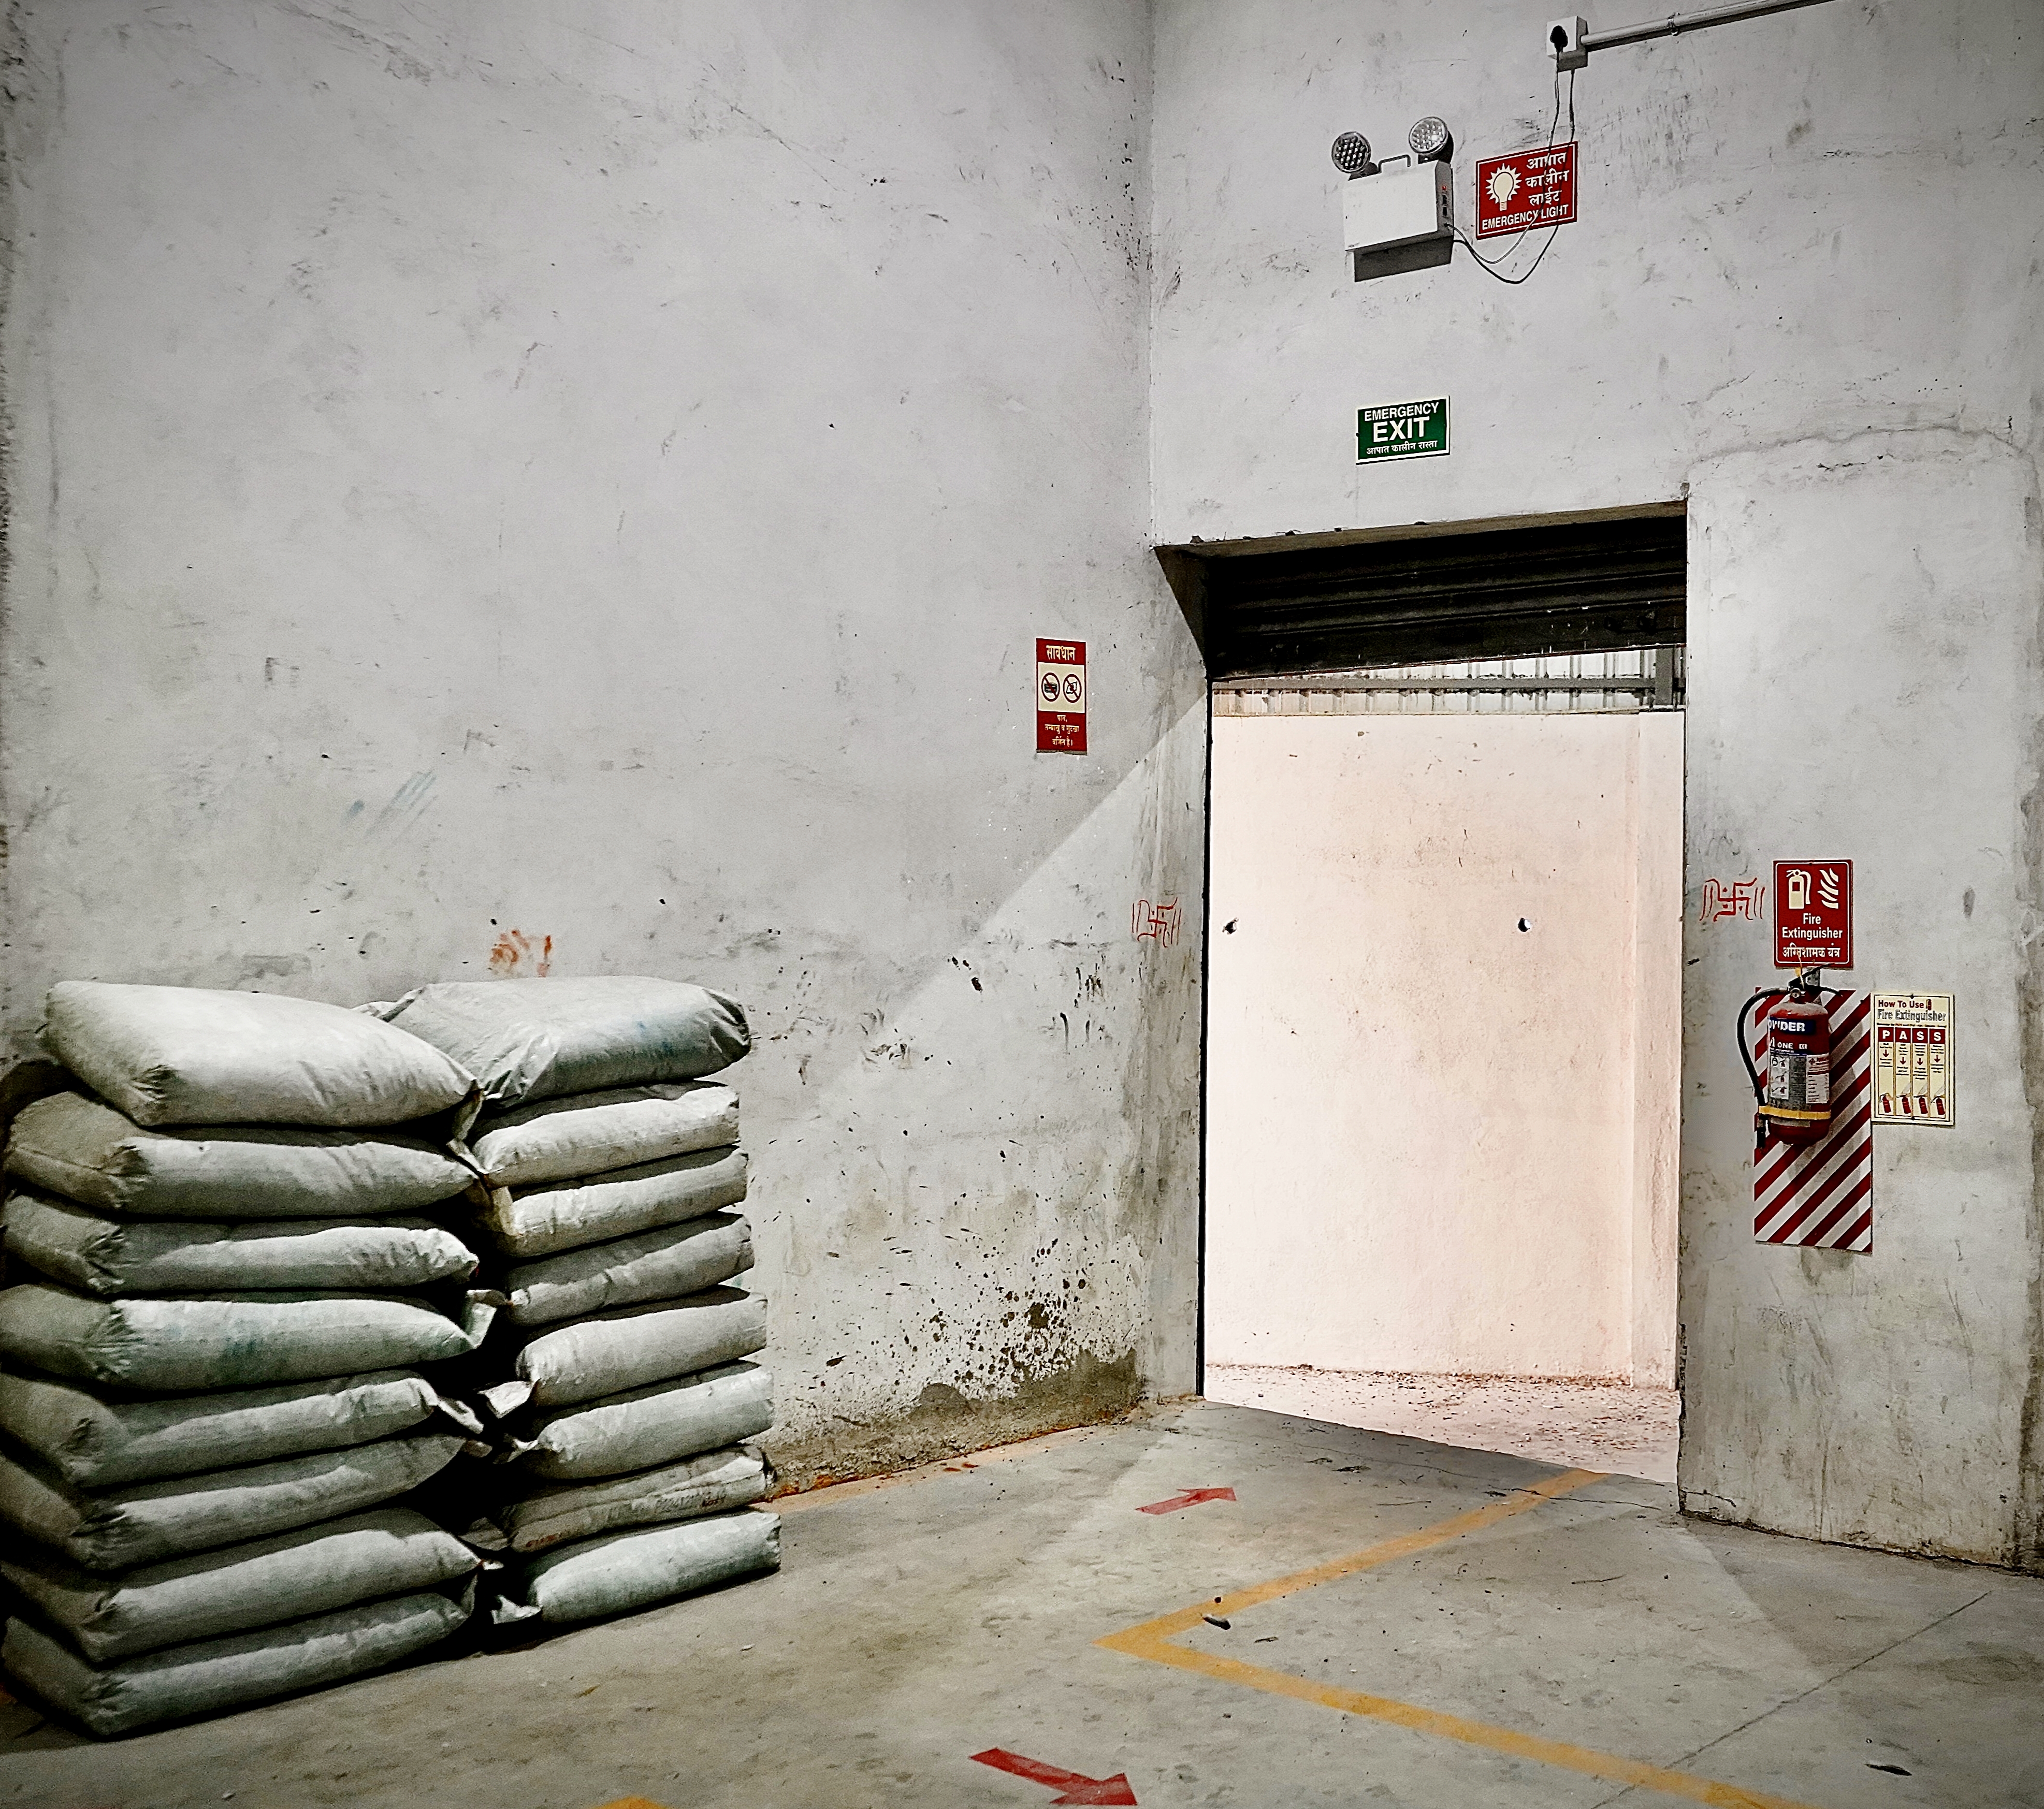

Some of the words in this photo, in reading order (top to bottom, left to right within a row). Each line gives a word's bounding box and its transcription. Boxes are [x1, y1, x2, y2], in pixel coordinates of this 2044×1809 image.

[1526, 152, 1567, 169] आपात
[1525, 168, 1570, 187] कालीन
[1528, 186, 1562, 206] लाईट
[1482, 209, 1539, 230] EMERGENCY
[1541, 205, 1569, 218] LIGHT
[1365, 402, 1439, 421] EMERGENCY
[1373, 416, 1430, 443] EXIT
[1366, 446, 1389, 455] आपात
[1391, 441, 1416, 452] कालीन
[1418, 440, 1438, 449] रास्ता
[1046, 645, 1076, 661] सावधान
[1803, 913, 1821, 924] Fire
[1782, 927, 1843, 941] Extinguisher
[1782, 942, 1825, 958] अग्निशामक
[1827, 942, 1840, 957] यंत्र
[1877, 1009, 1893, 1019] Fire
[1895, 1009, 1947, 1023] Extinguisher
[1768, 1019, 1805, 1031] OWDER
[1882, 1030, 1890, 1039] P
[1899, 1030, 1907, 1040] A
[1917, 1031, 1924, 1041] S
[1934, 1031, 1941, 1041] S
